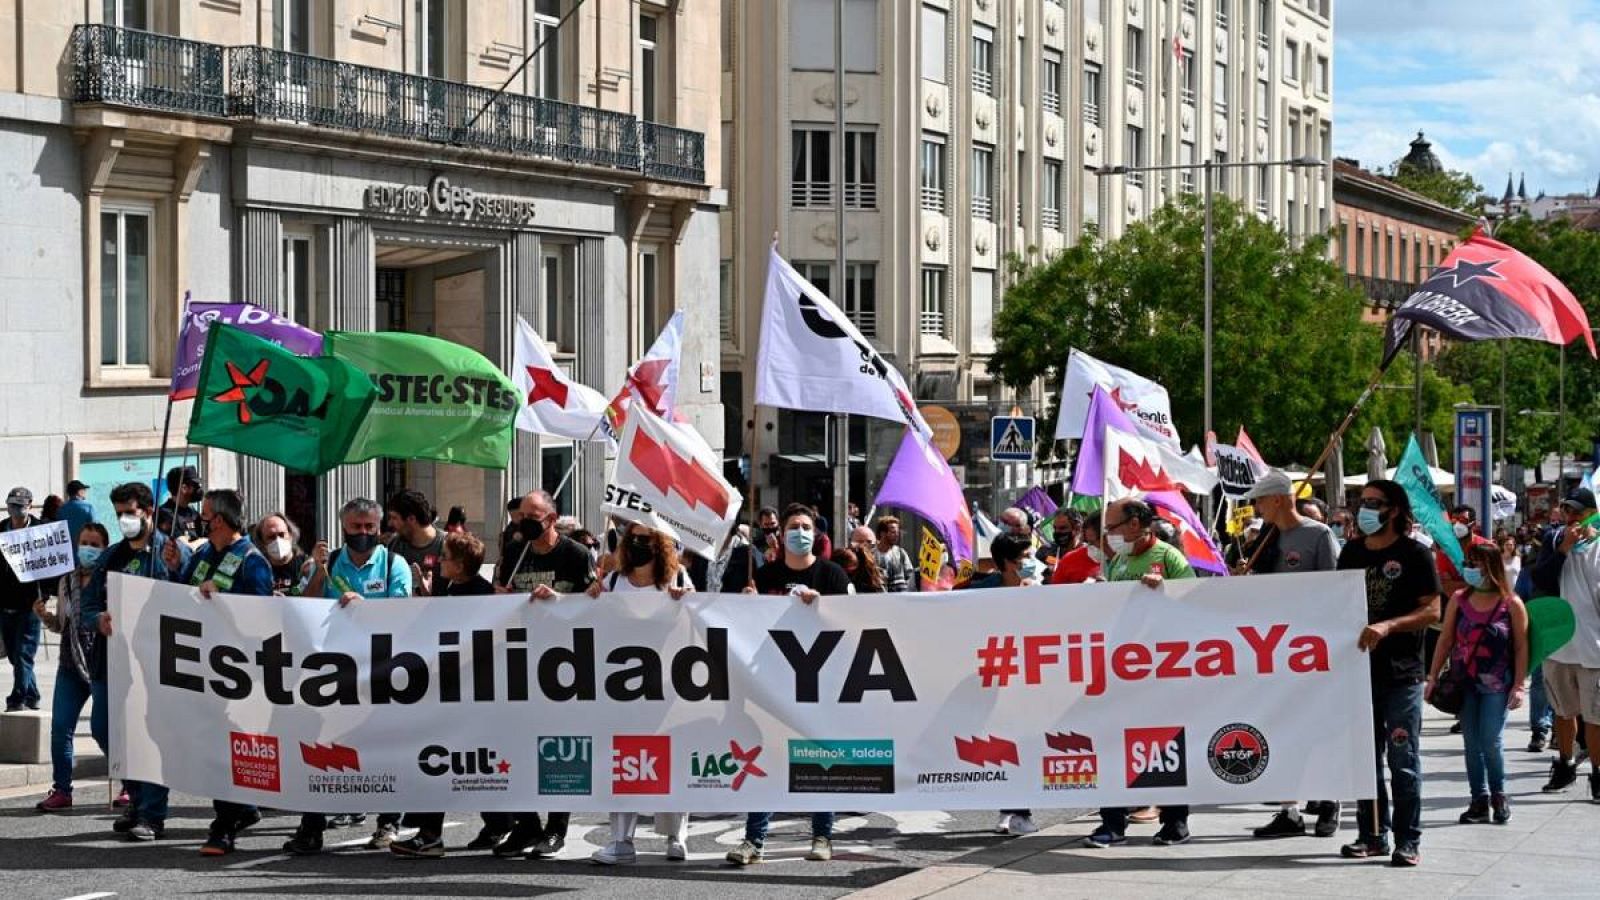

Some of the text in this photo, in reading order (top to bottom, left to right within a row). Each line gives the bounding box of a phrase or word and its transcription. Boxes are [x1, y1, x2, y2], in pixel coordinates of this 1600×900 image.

[433, 176, 475, 213] Ges
[478, 197, 537, 219] SEGUROS
[159, 614, 1330, 706] Estabilidad YA #FijezaYa
[232, 737, 277, 760] co.bas
[540, 736, 592, 762] CUT
[1131, 740, 1180, 774] SAS
[308, 772, 397, 783] CONFEDERACIÓN
[611, 749, 659, 782] Esk
[917, 771, 1009, 784] INTERSINDICAL
[309, 783, 396, 793] INTERSINDICAL
